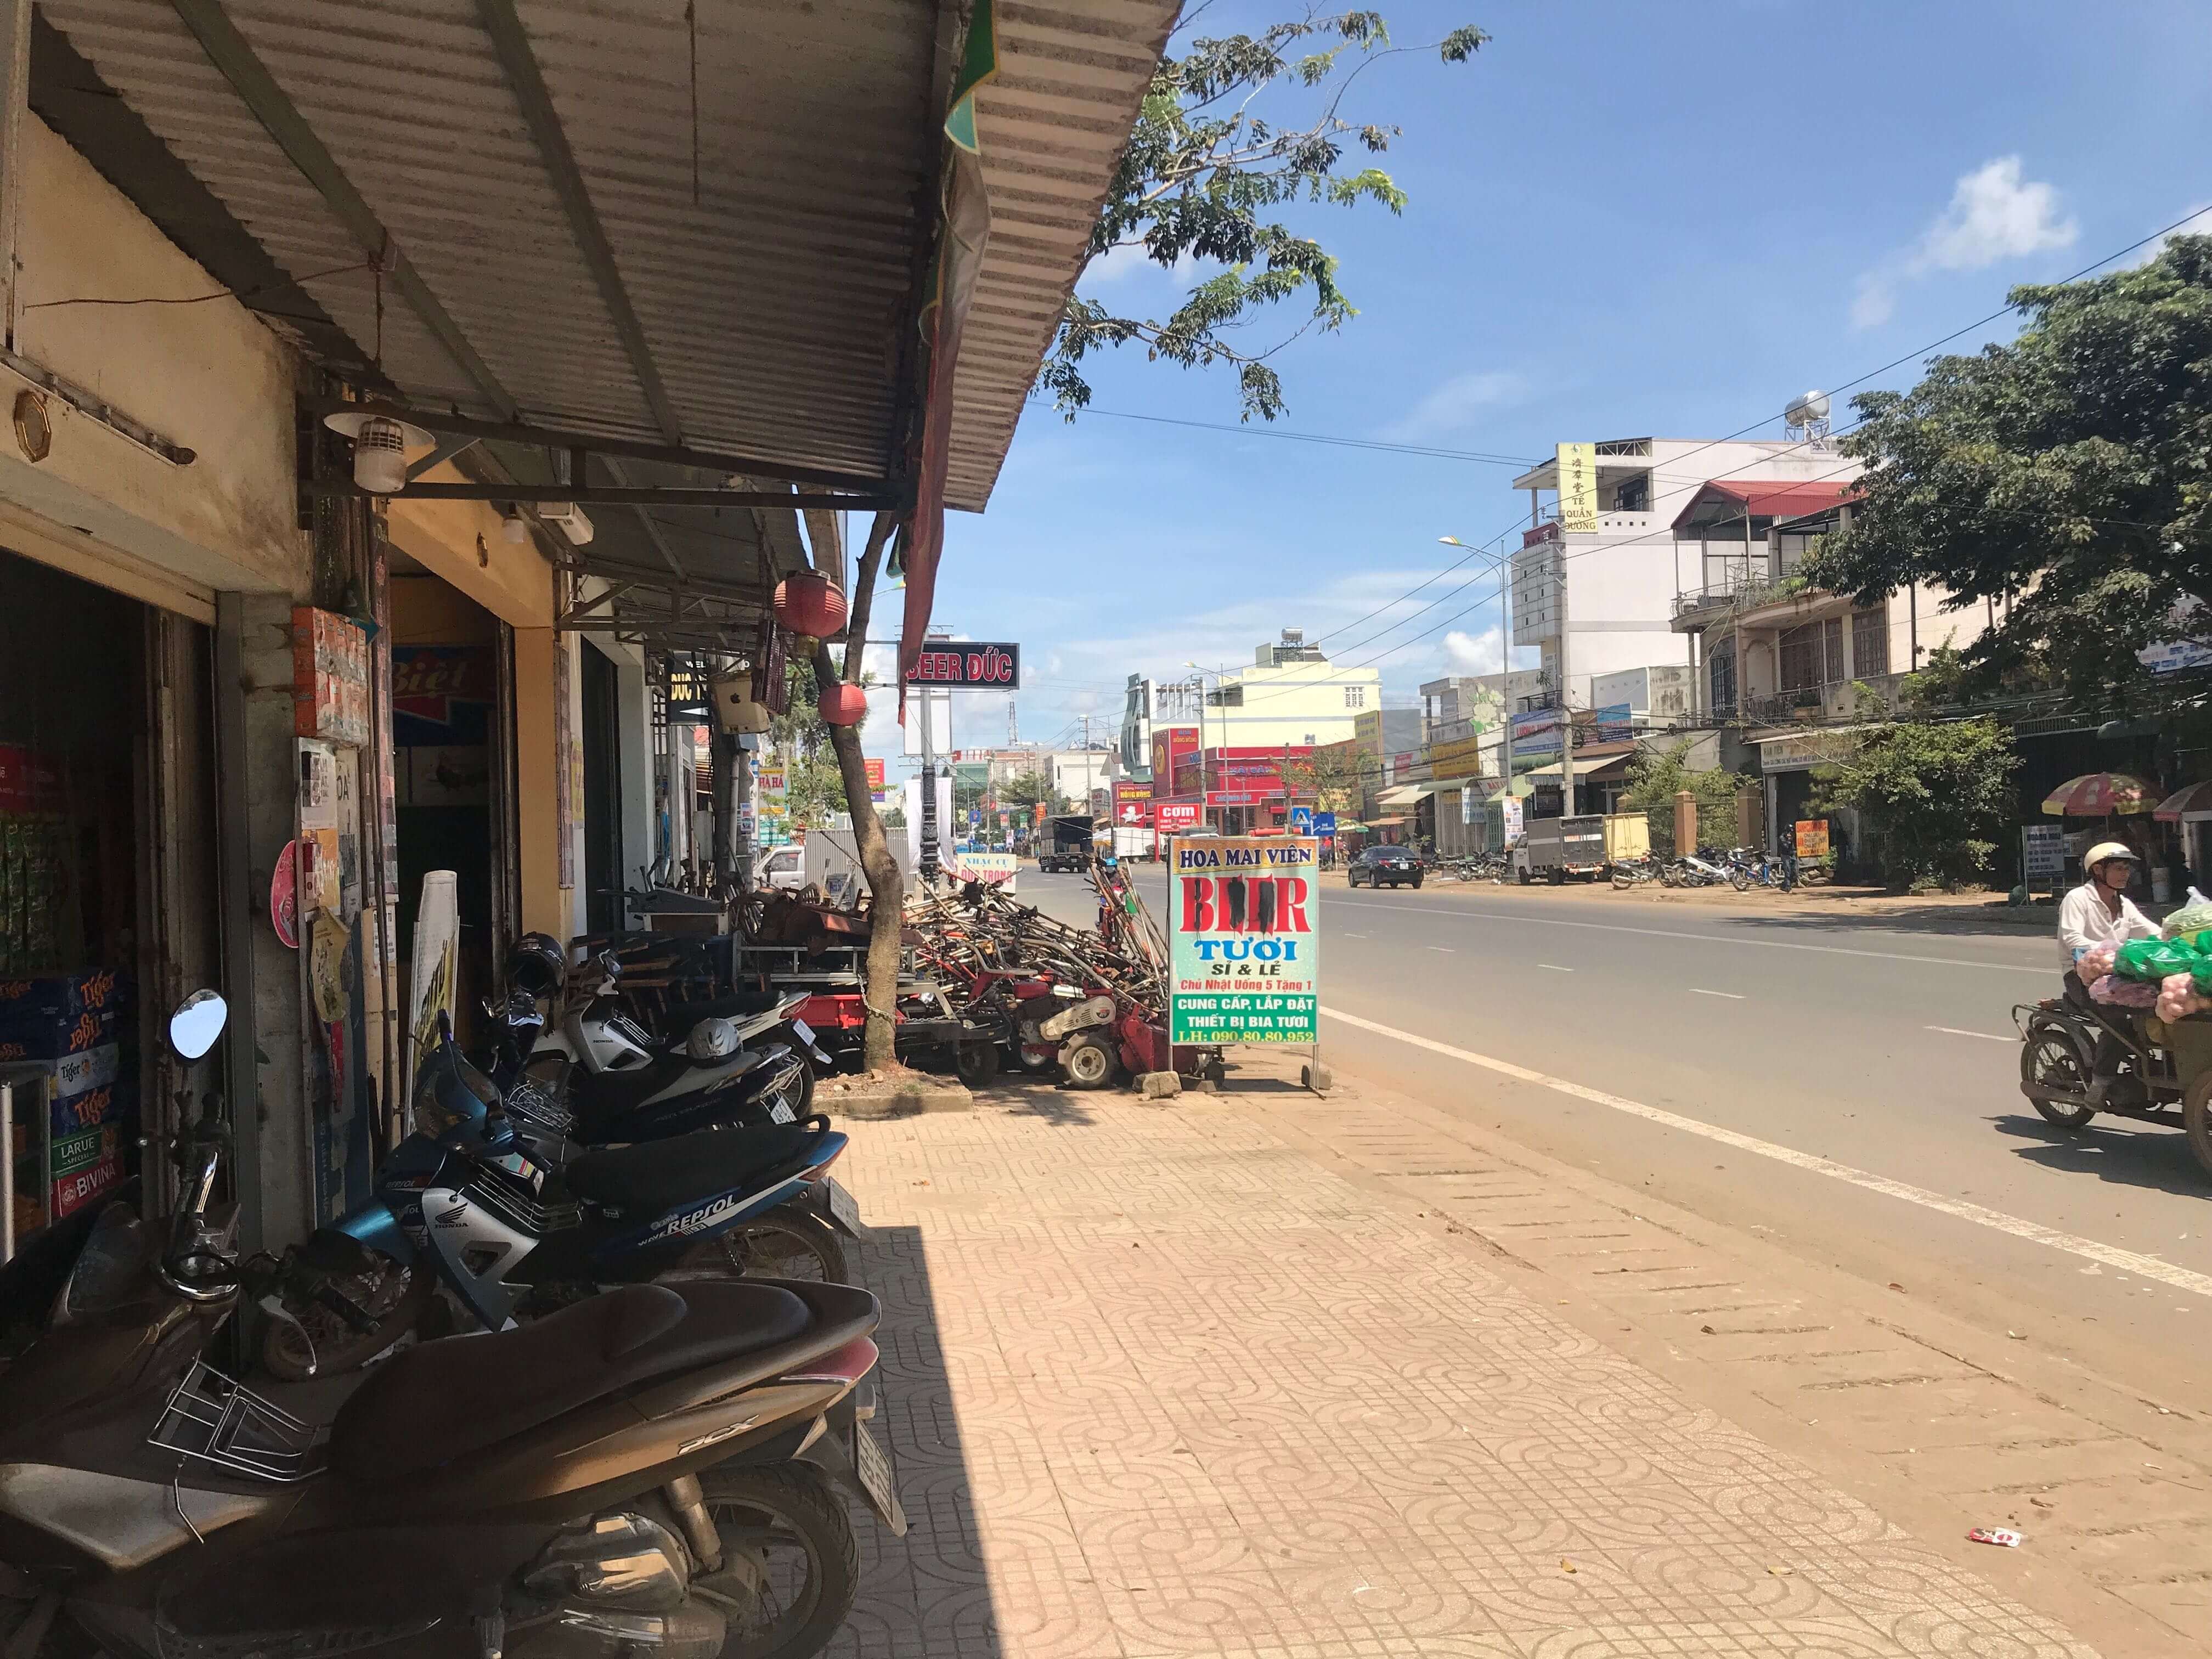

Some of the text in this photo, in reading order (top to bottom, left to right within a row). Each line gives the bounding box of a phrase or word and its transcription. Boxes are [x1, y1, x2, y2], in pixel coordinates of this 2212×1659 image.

[967, 646, 1012, 682] ĐỨC
[1163, 806, 1195, 817] cơm
[966, 857, 1009, 867] NHẠC CỤ
[1180, 845, 1312, 868] HOA MAI VIÊN
[1193, 936, 1298, 961] TƯƠI
[1211, 961, 1281, 976] SỈ & LẺ
[1181, 978, 1312, 991] Chủ Nhật Uống 5 Tặng 1
[1178, 996, 1314, 1012] CUNG CẤP, LẮP ĐẶT
[1187, 1013, 1308, 1029] THIẾT BỊ BIA TƯƠI
[1179, 1031, 1314, 1042] LH: 090.80.80.952
[61, 1063, 80, 1082] Tiger
[61, 1136, 95, 1159] LARUE
[67, 1153, 89, 1165] SPECIAL
[77, 1163, 115, 1198] BIVINA
[667, 1194, 735, 1234] REPSOL
